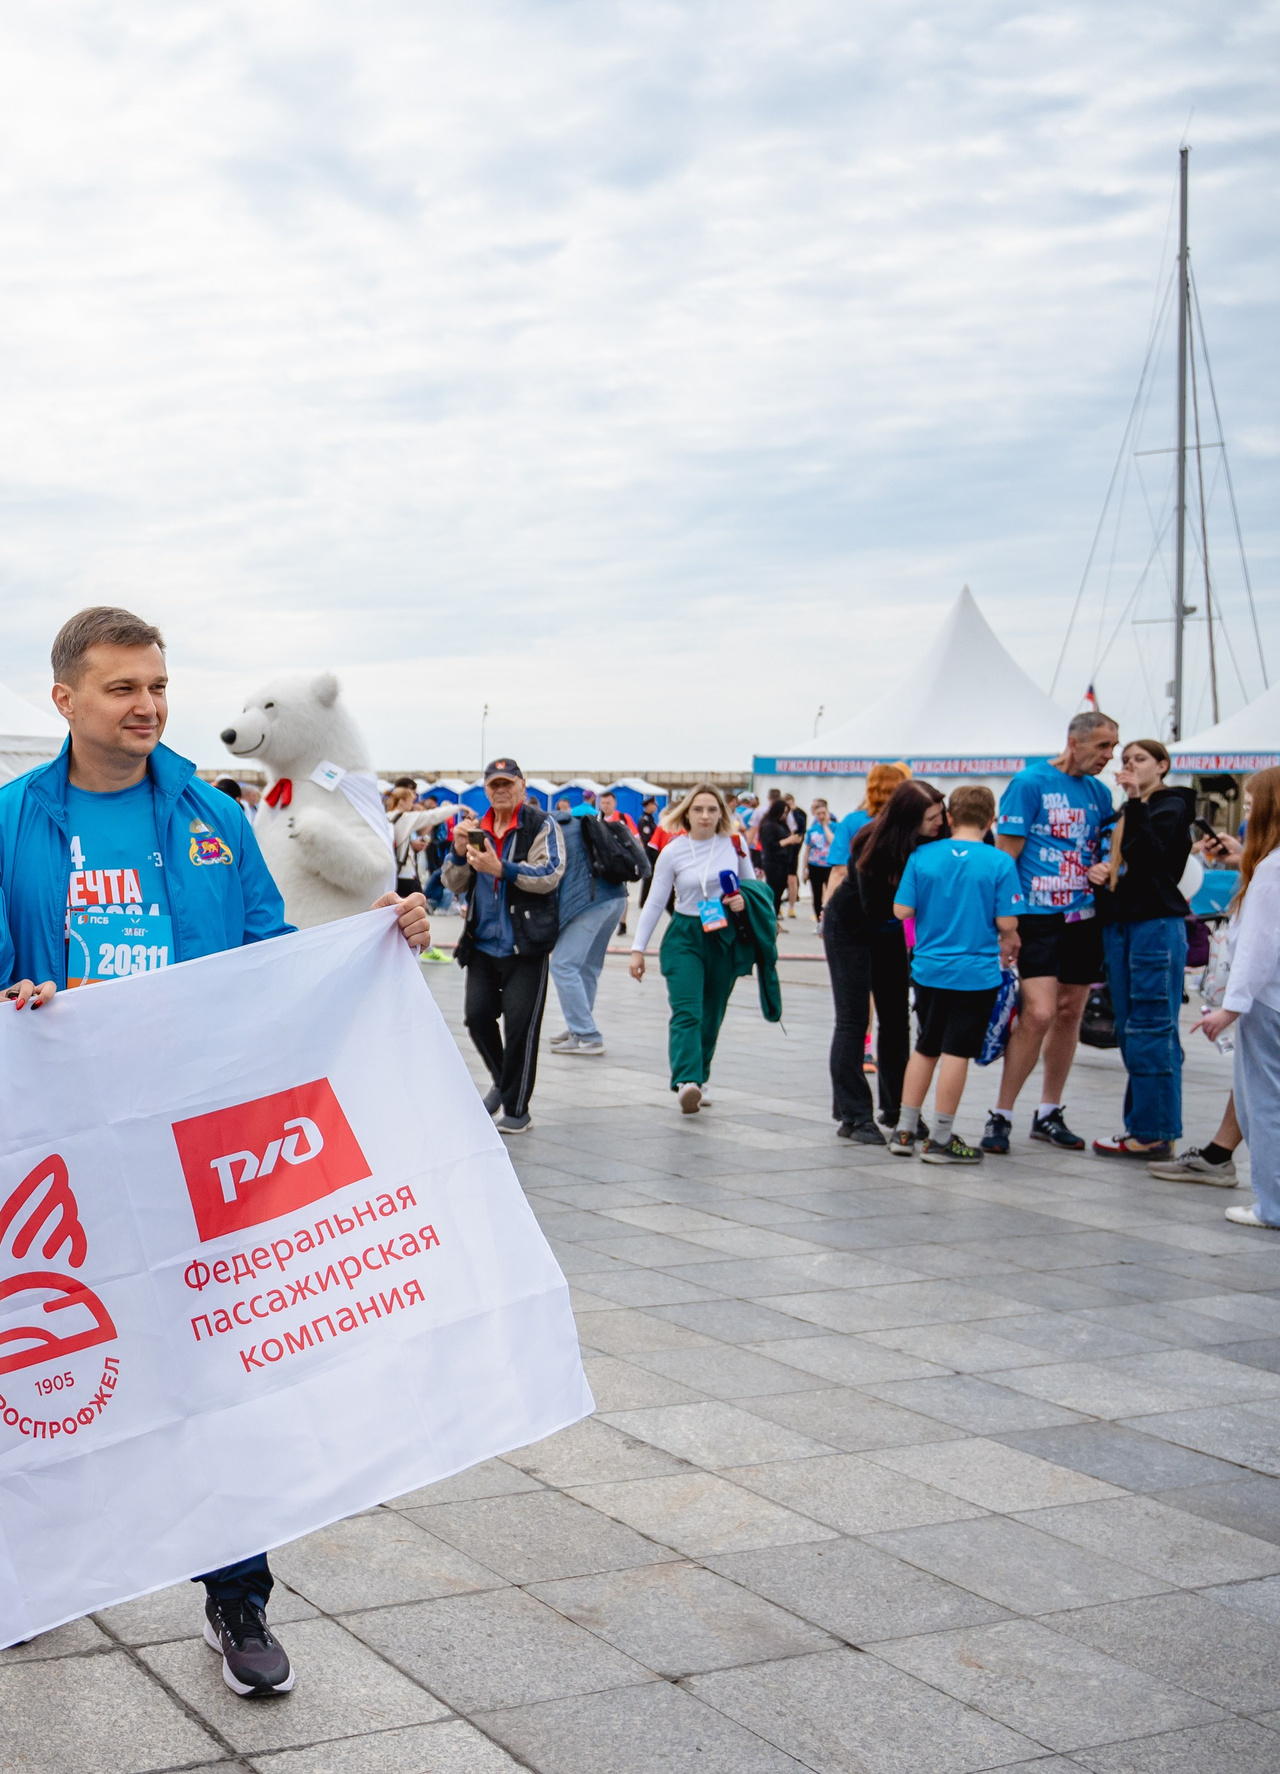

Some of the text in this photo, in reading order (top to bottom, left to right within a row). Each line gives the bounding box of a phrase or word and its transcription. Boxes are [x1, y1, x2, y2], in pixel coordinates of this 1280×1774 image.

[776, 759, 821, 773] МУЖСКАЯ
[90, 916, 109, 925] ПСБ
[97, 943, 168, 976] 20311
[184, 1185, 417, 1292] Федеральная
[190, 1224, 441, 1342] пассажирская
[239, 1279, 426, 1373] компания
[34, 1371, 75, 1397] 1905
